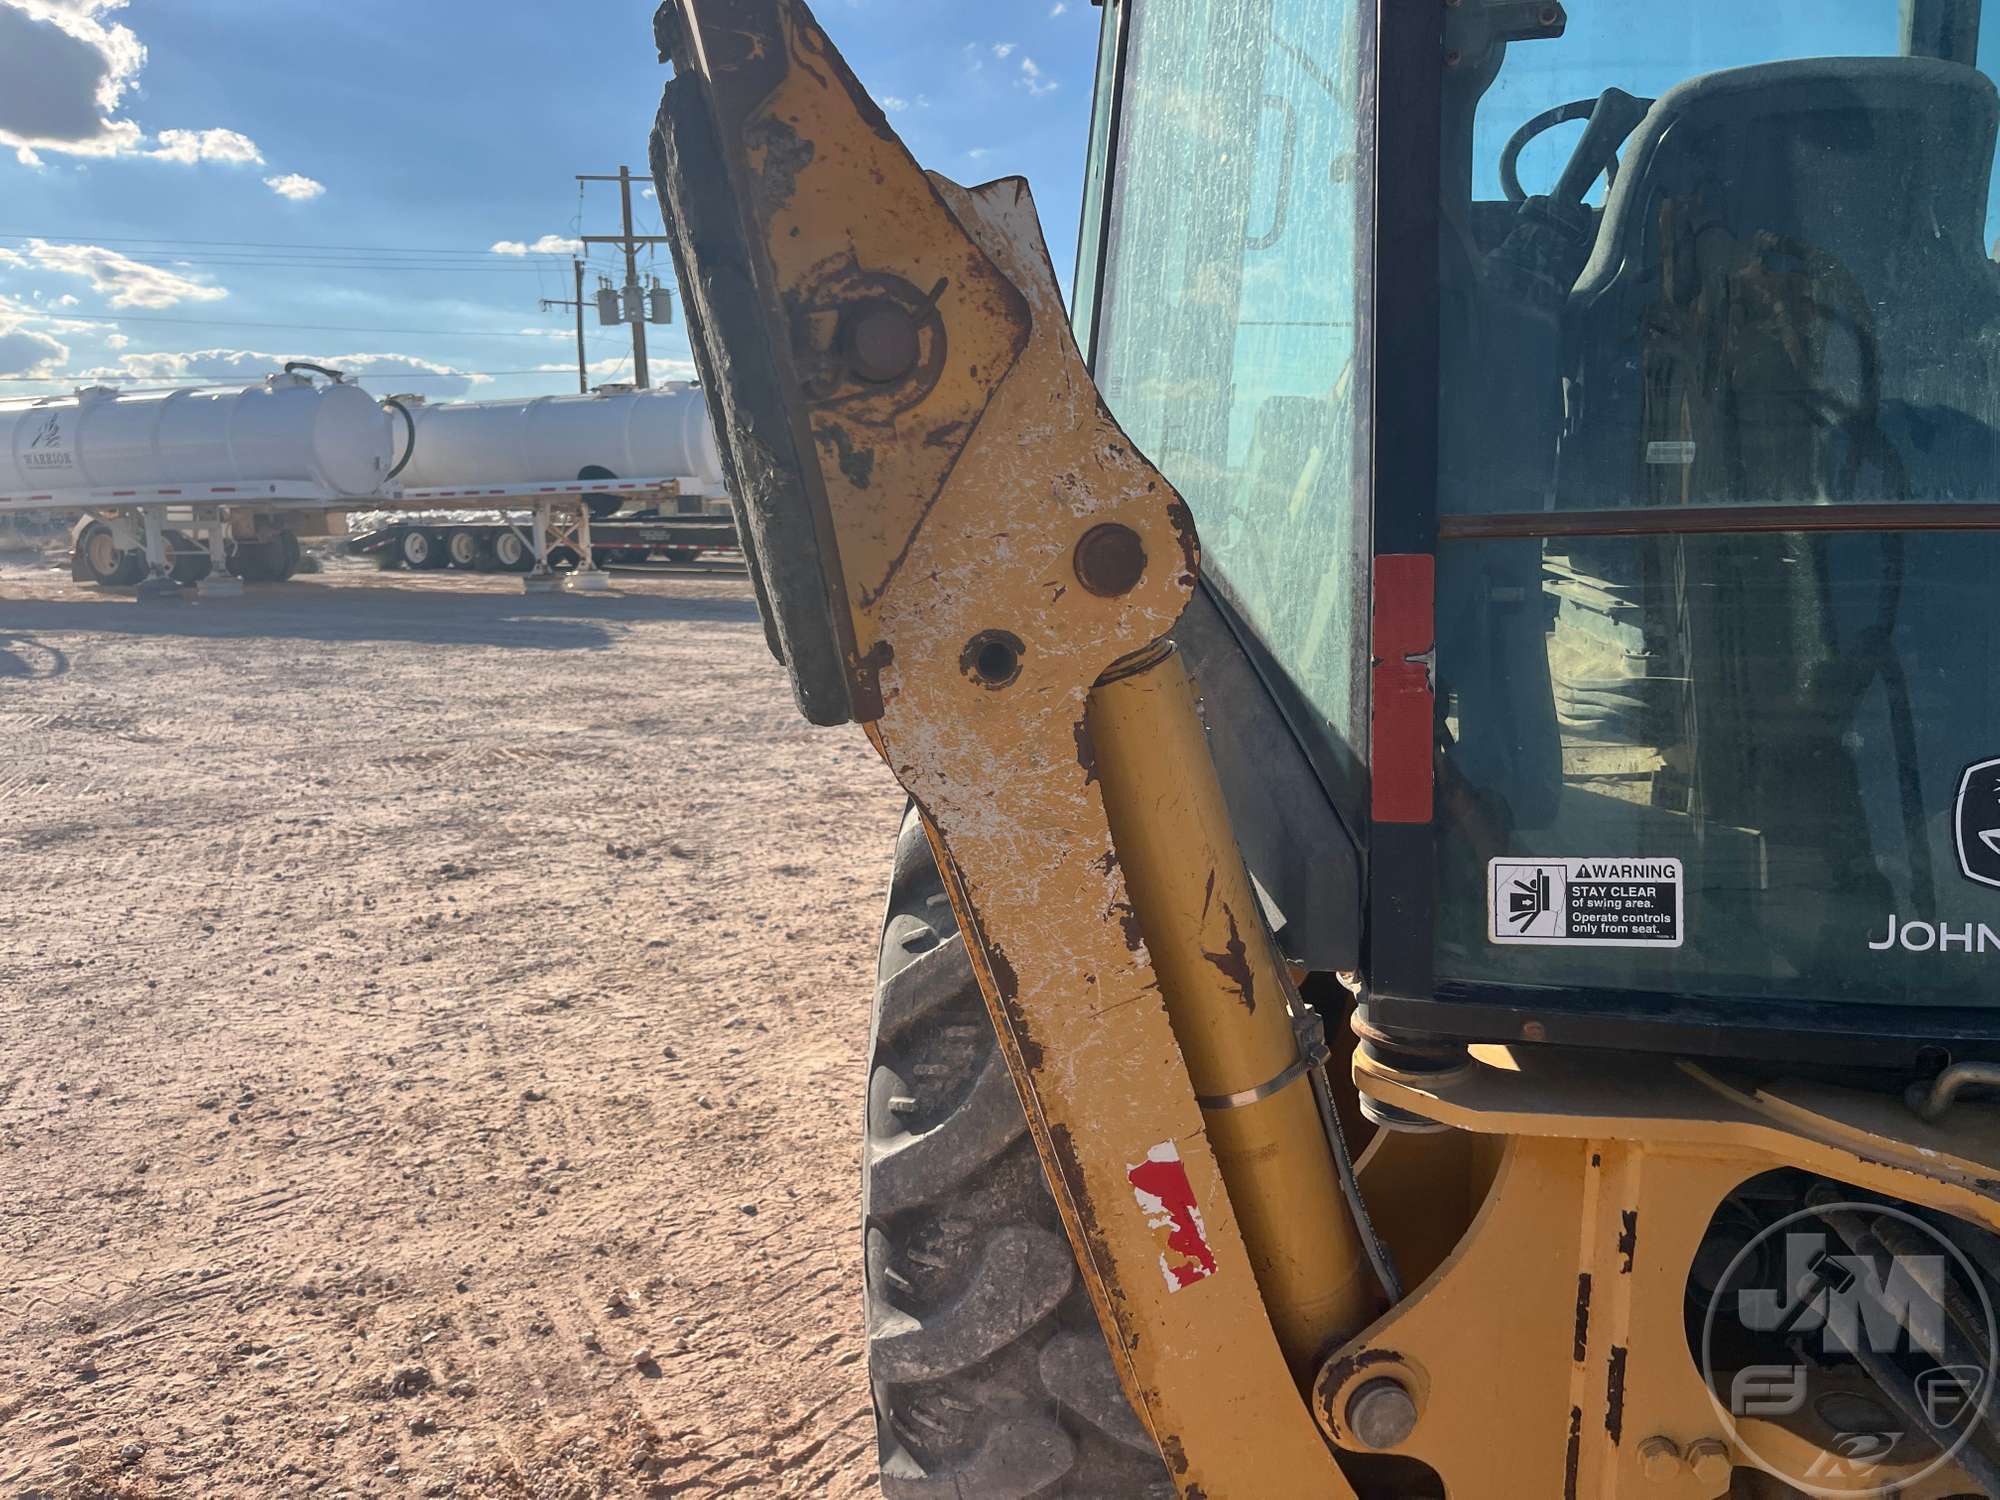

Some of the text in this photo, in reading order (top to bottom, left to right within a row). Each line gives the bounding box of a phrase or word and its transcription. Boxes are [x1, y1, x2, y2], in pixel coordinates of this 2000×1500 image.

[23, 452, 73, 465] WARRIOR
[1592, 864, 1676, 879] WARNING
[1572, 886, 1656, 898] STAY CLEAR
[1572, 898, 1654, 910] of swing area.
[1572, 912, 1671, 924] Operate controls
[1572, 923, 1660, 935] only from seat.
[1868, 914, 2000, 953] JOHN
